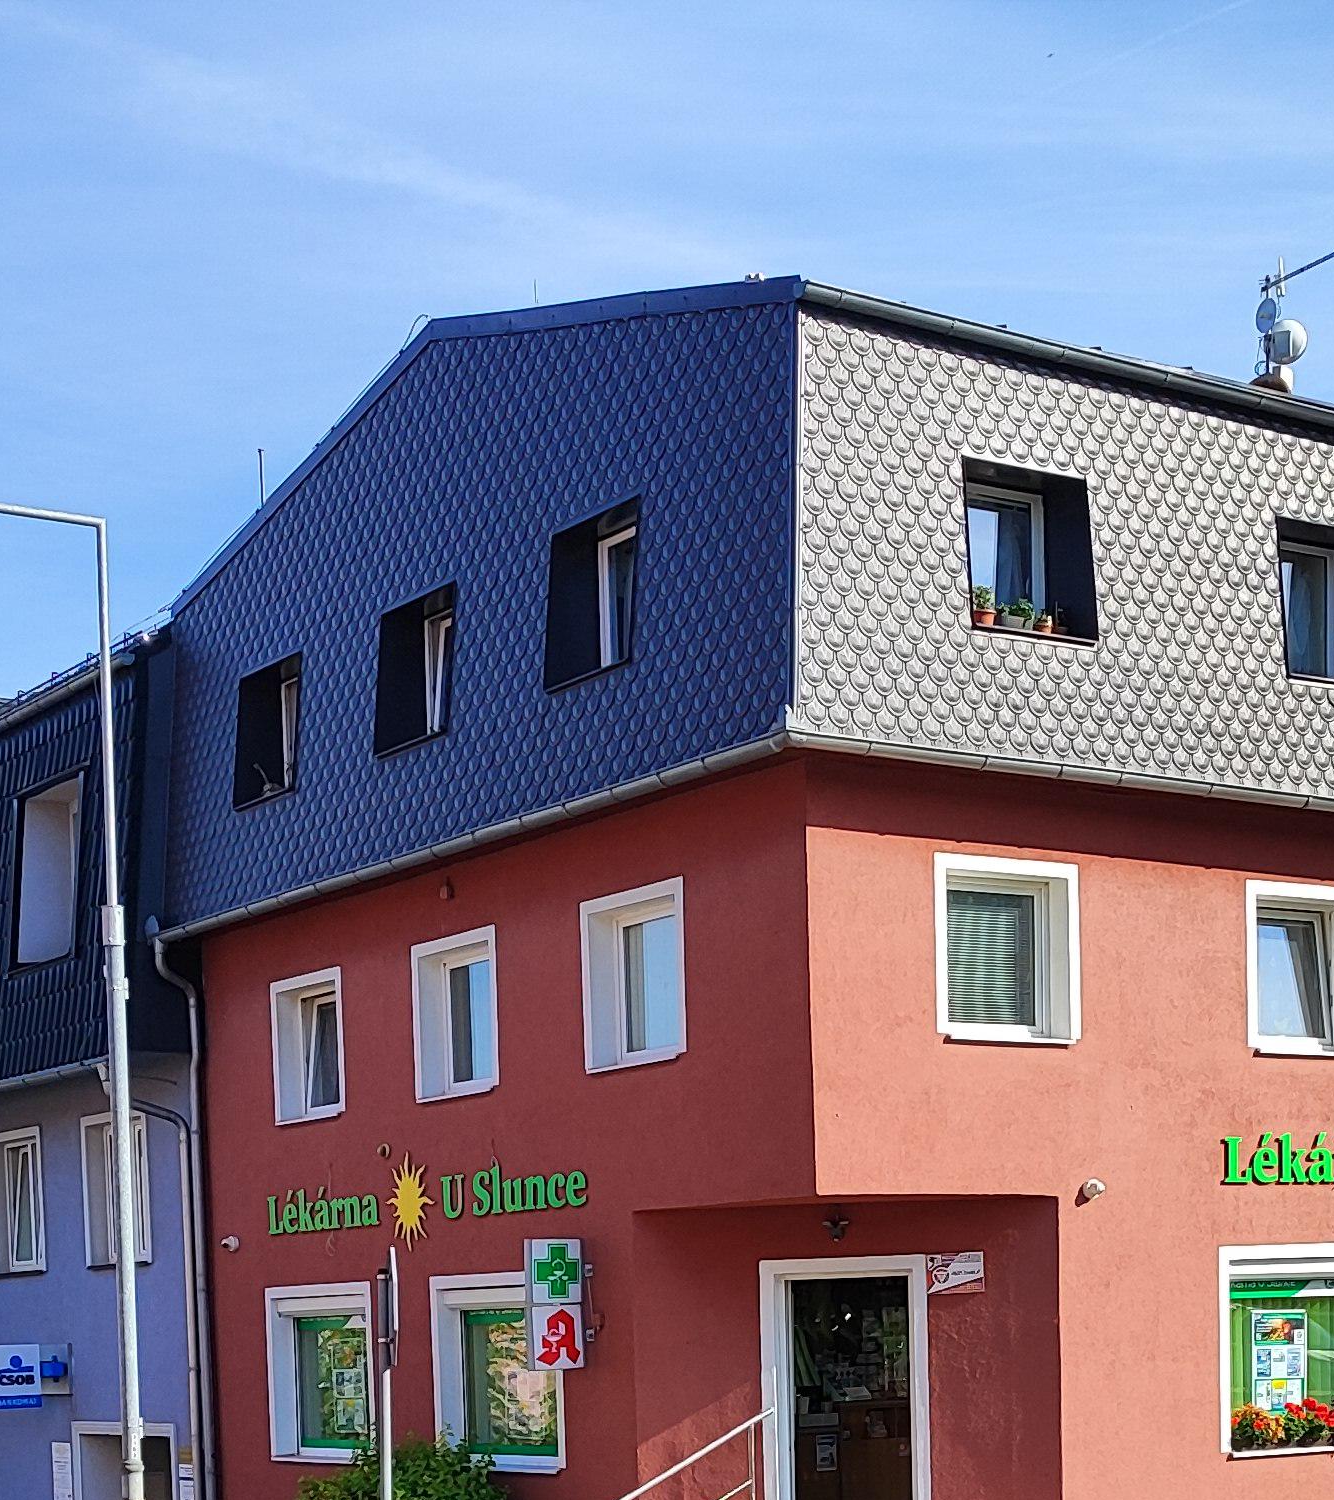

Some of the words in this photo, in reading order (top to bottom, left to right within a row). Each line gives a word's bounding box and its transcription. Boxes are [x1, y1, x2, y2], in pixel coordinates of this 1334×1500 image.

[268, 1187, 380, 1235] Lékárna
[441, 1174, 464, 1219] U
[472, 1161, 587, 1216] Slunce
